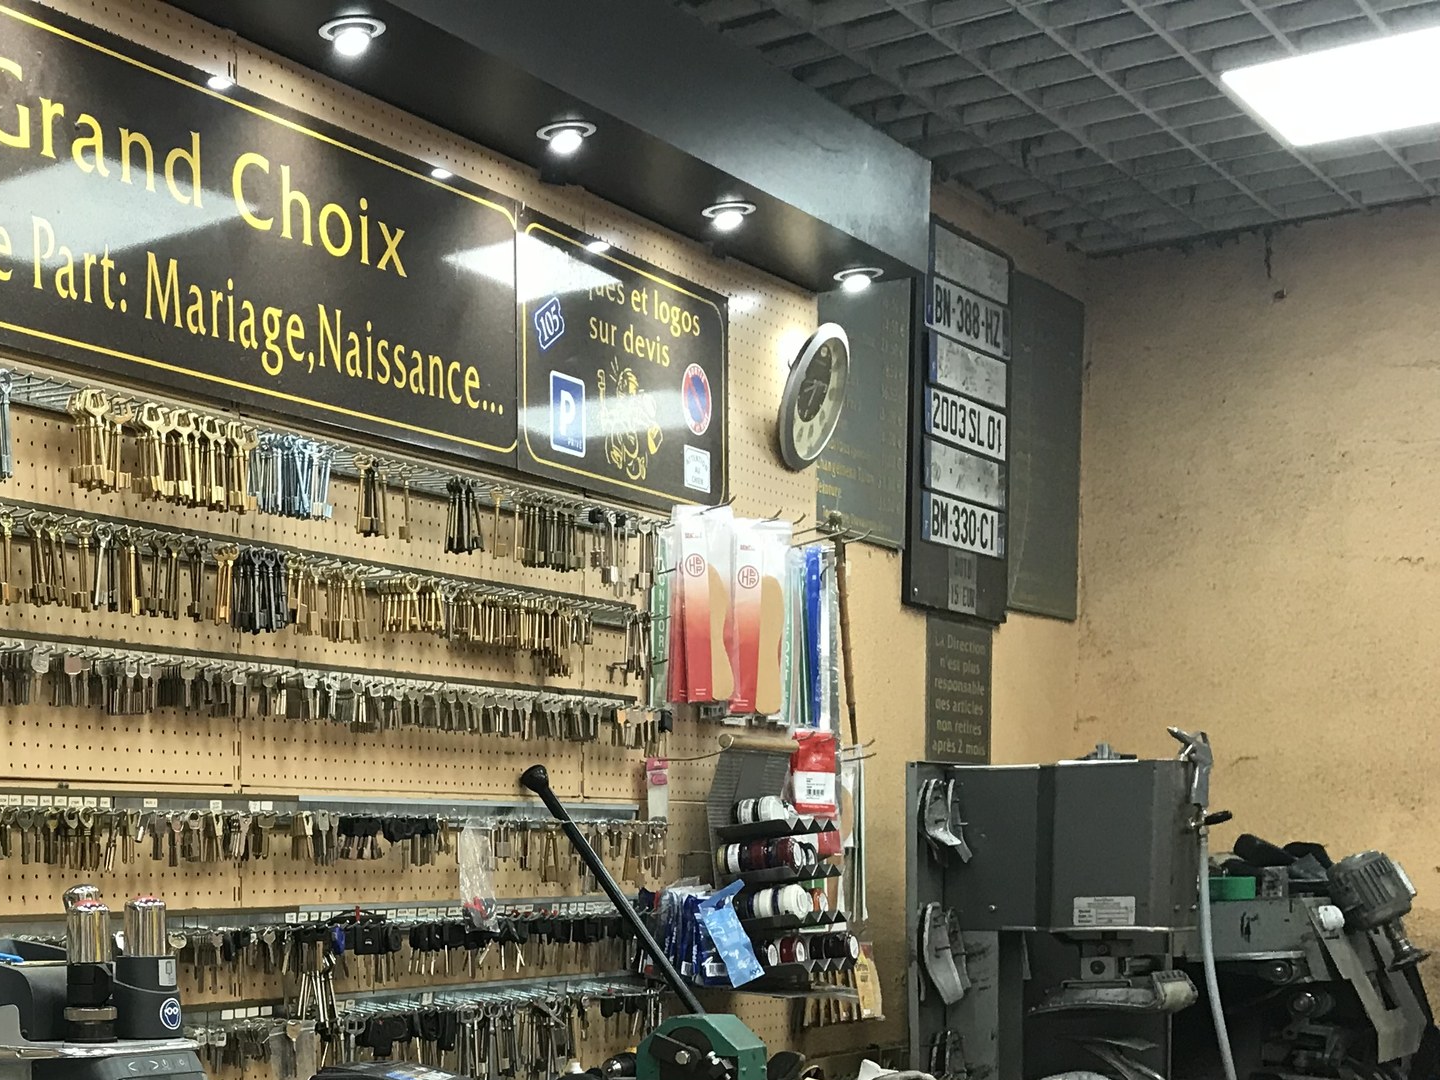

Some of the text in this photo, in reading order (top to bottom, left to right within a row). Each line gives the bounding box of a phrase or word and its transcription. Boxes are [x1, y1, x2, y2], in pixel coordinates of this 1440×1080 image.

[232, 151, 408, 279] Choix
[32, 215, 128, 314] Part:
[540, 303, 560, 342] 105
[631, 288, 649, 316] et
[653, 290, 700, 337] logos
[589, 316, 670, 367] sur devis
[560, 389, 576, 436] P
[933, 391, 1002, 454] 2003 SL 01
[947, 633, 986, 655] Direction
[934, 676, 985, 697] responsable
[962, 659, 980, 676] plus
[935, 696, 984, 716] des articles
[936, 716, 953, 732] non
[932, 737, 986, 757] après 2 mois
